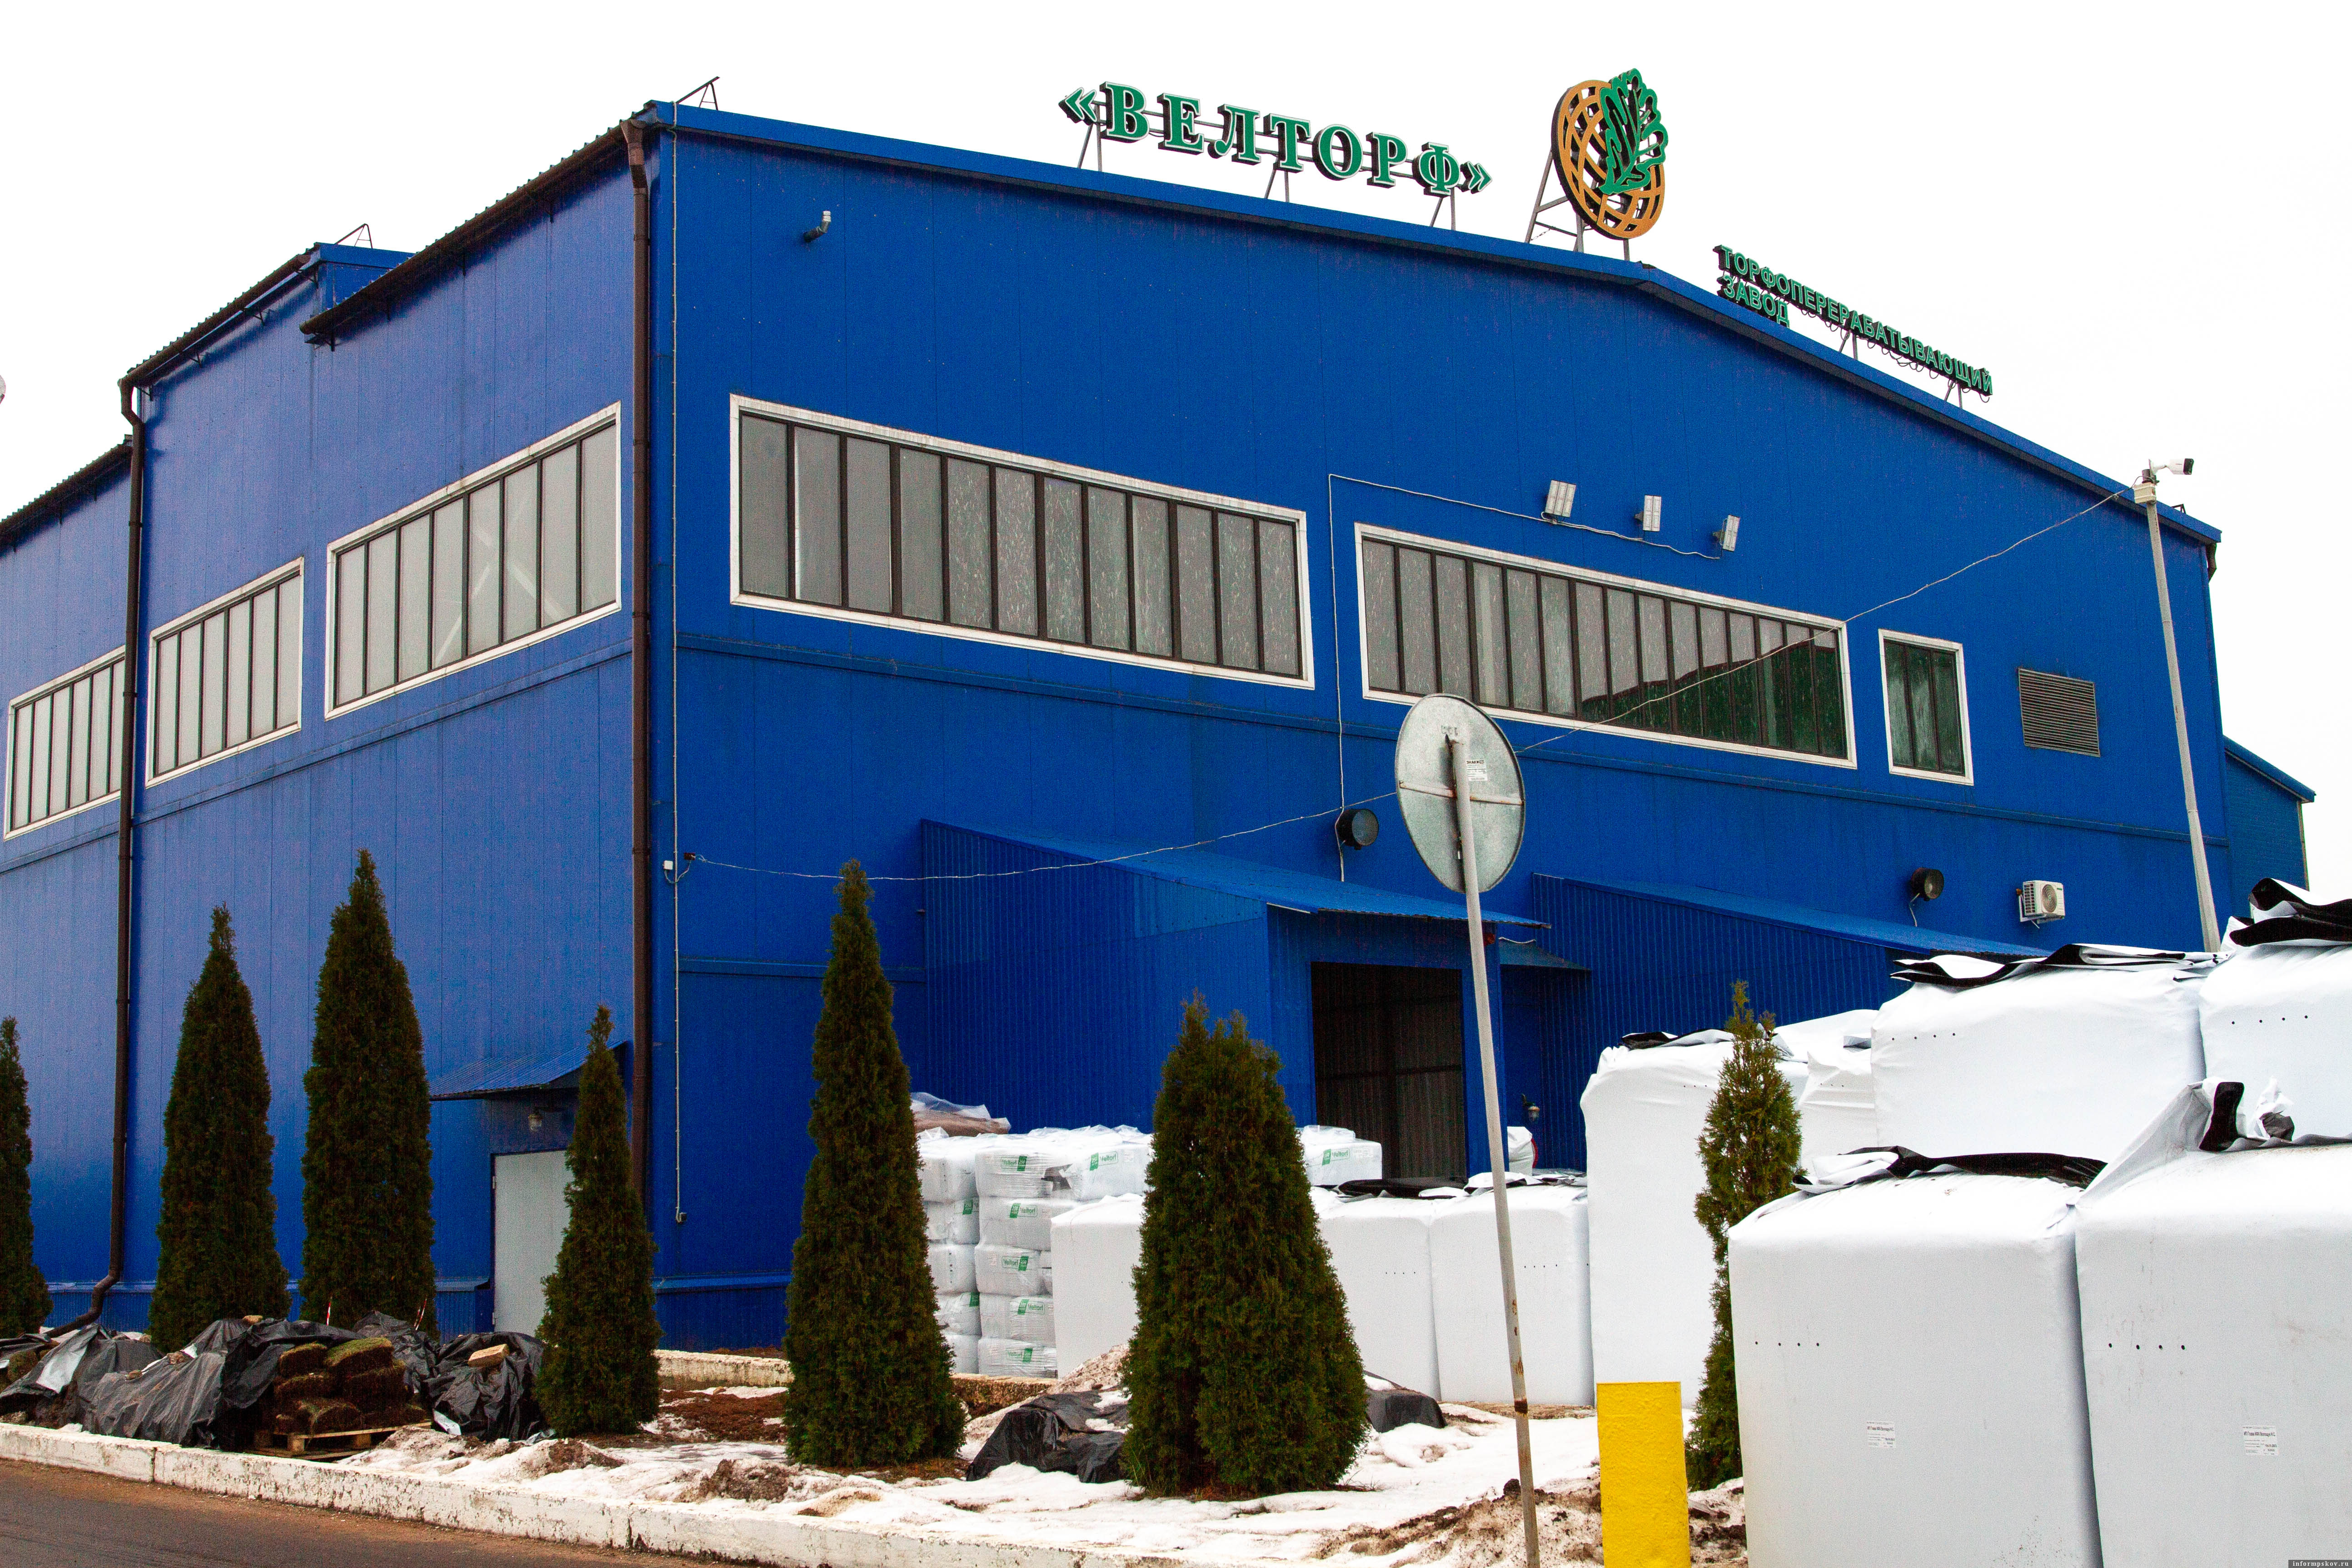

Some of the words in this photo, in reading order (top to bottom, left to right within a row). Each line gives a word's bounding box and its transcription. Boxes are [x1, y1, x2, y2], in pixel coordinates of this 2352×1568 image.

[1058, 81, 1493, 198] «ВЕЛТОРФ»
[1713, 244, 1993, 397] ТОРФОПЕРЕРАБАТЫВАЮЩИЙ
[1716, 274, 1790, 329] ЗАВОД
